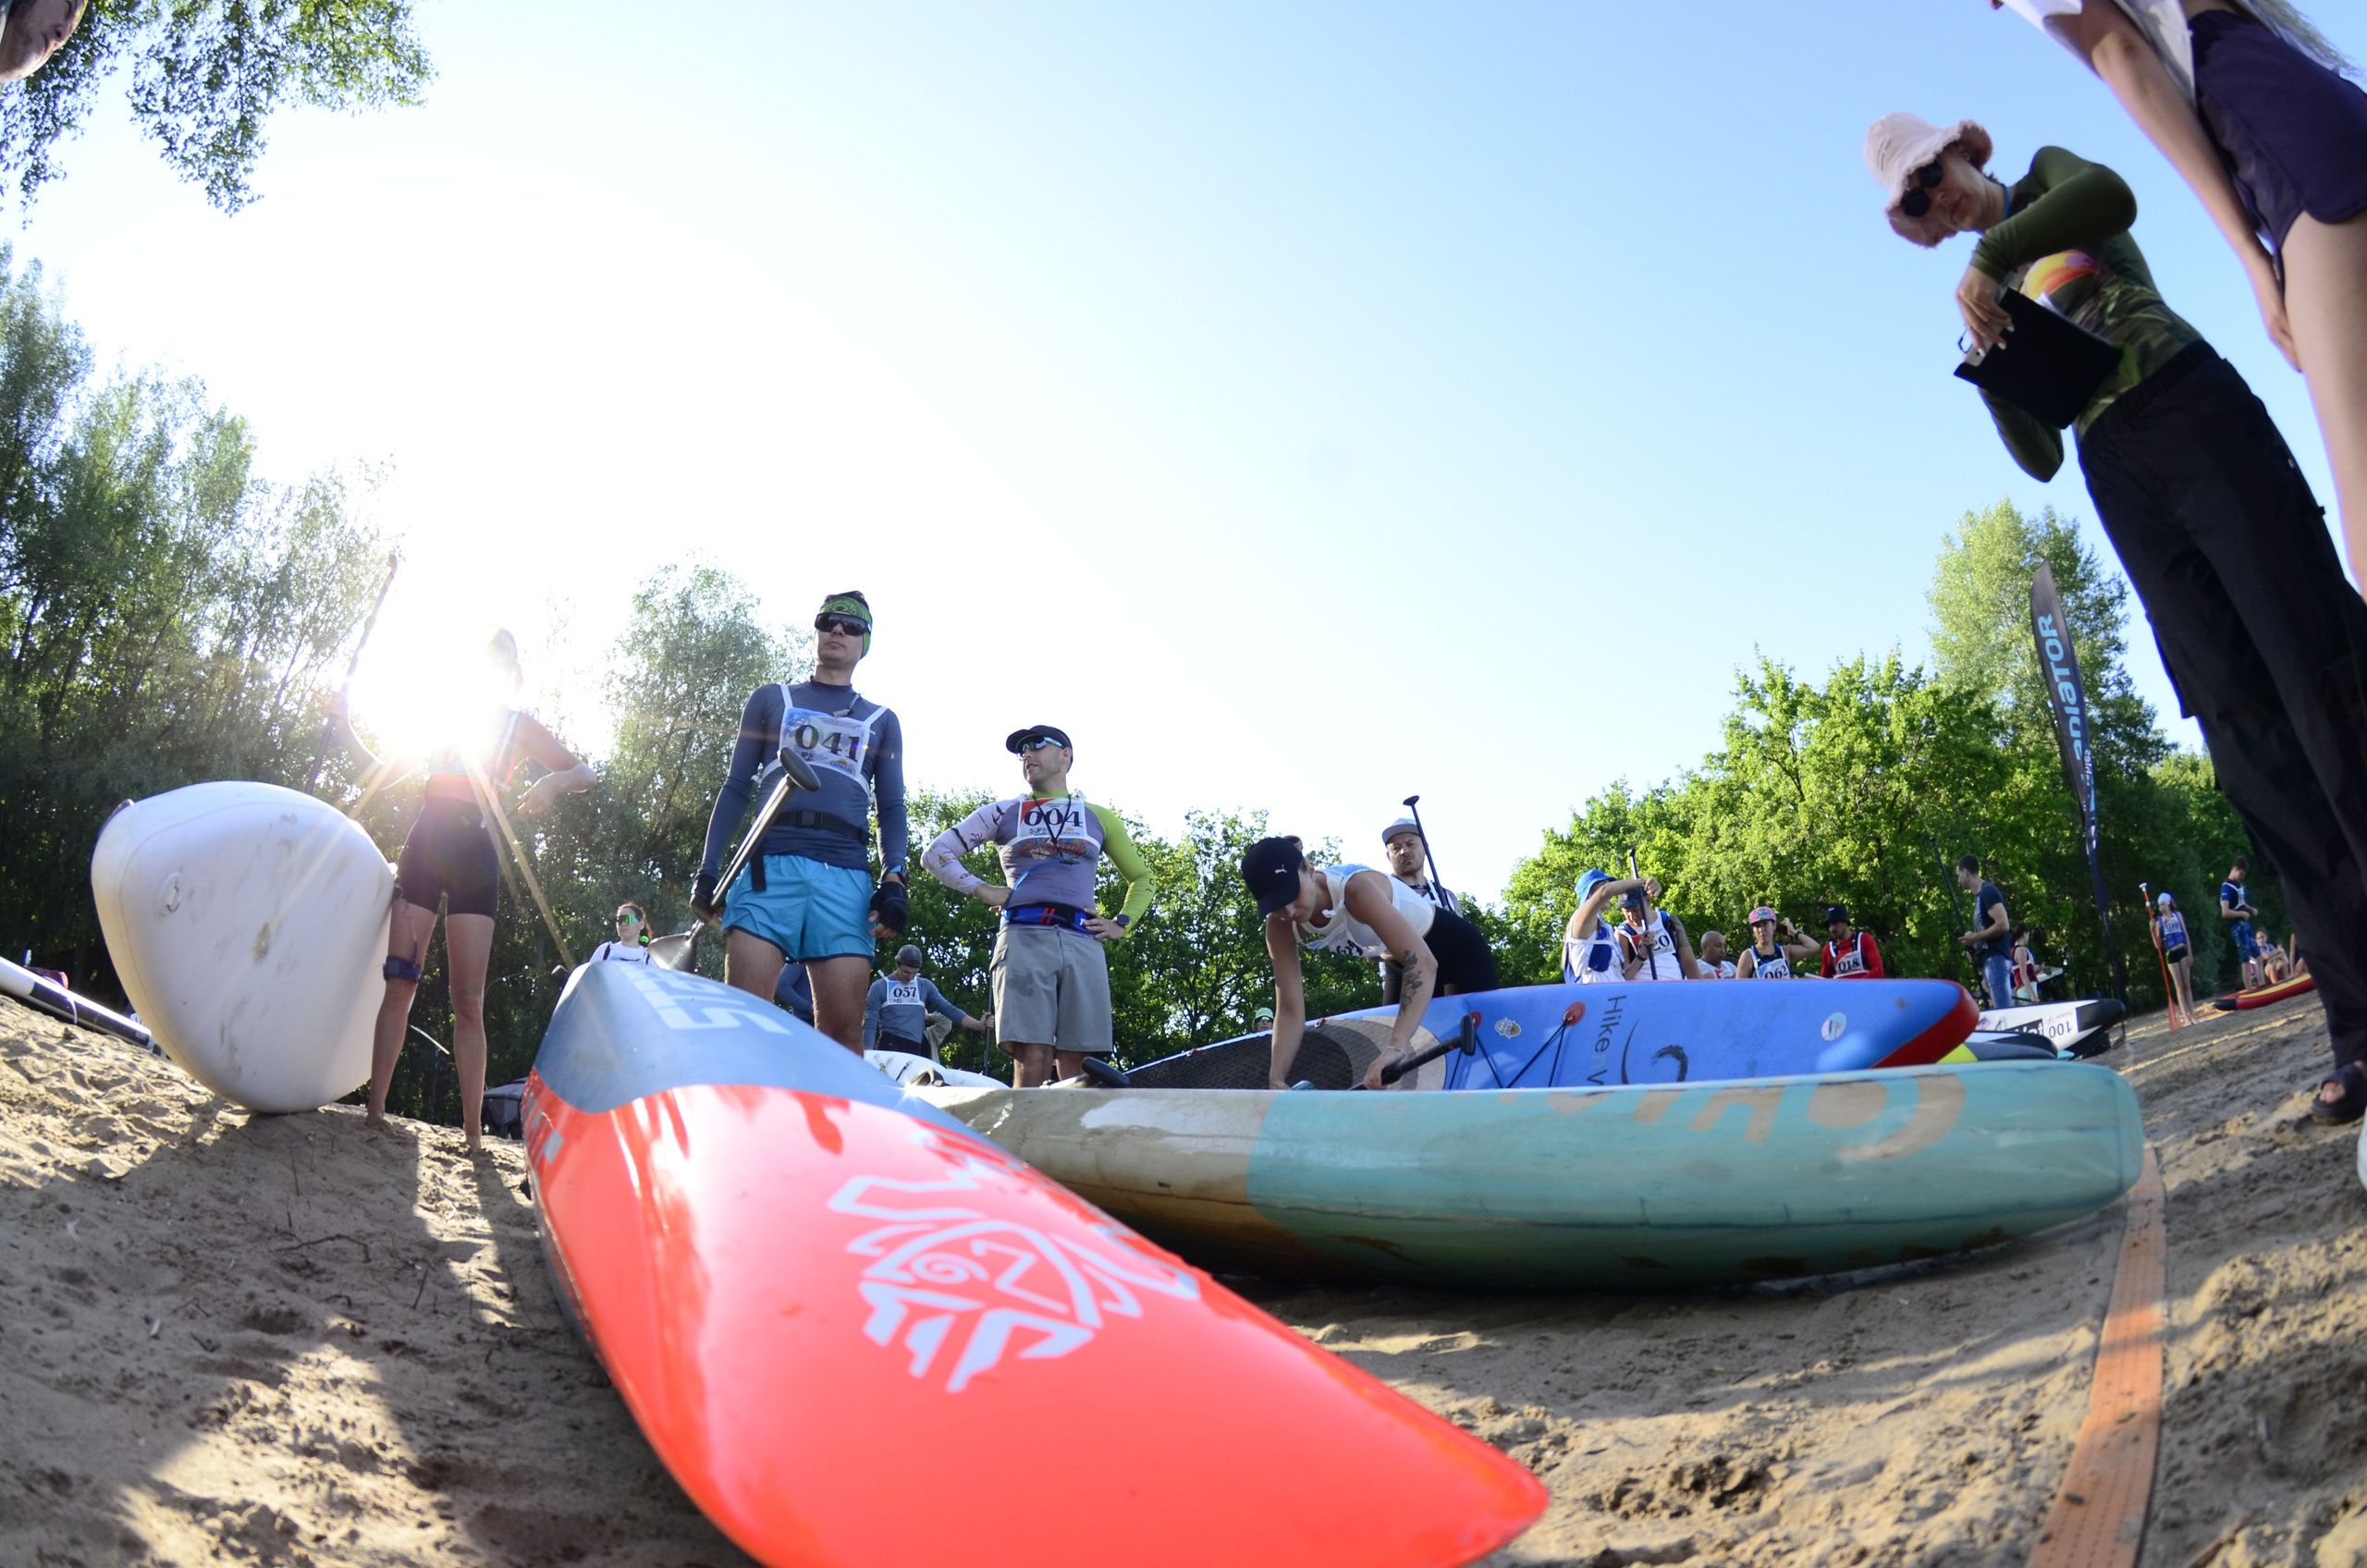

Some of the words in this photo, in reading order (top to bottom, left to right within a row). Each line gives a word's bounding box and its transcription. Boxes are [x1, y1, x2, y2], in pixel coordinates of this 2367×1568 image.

[795, 725, 860, 764] 041
[1024, 808, 1083, 828] 004
[1764, 965, 1789, 979] 062
[1838, 958, 1860, 972] 018
[893, 986, 917, 998] 057
